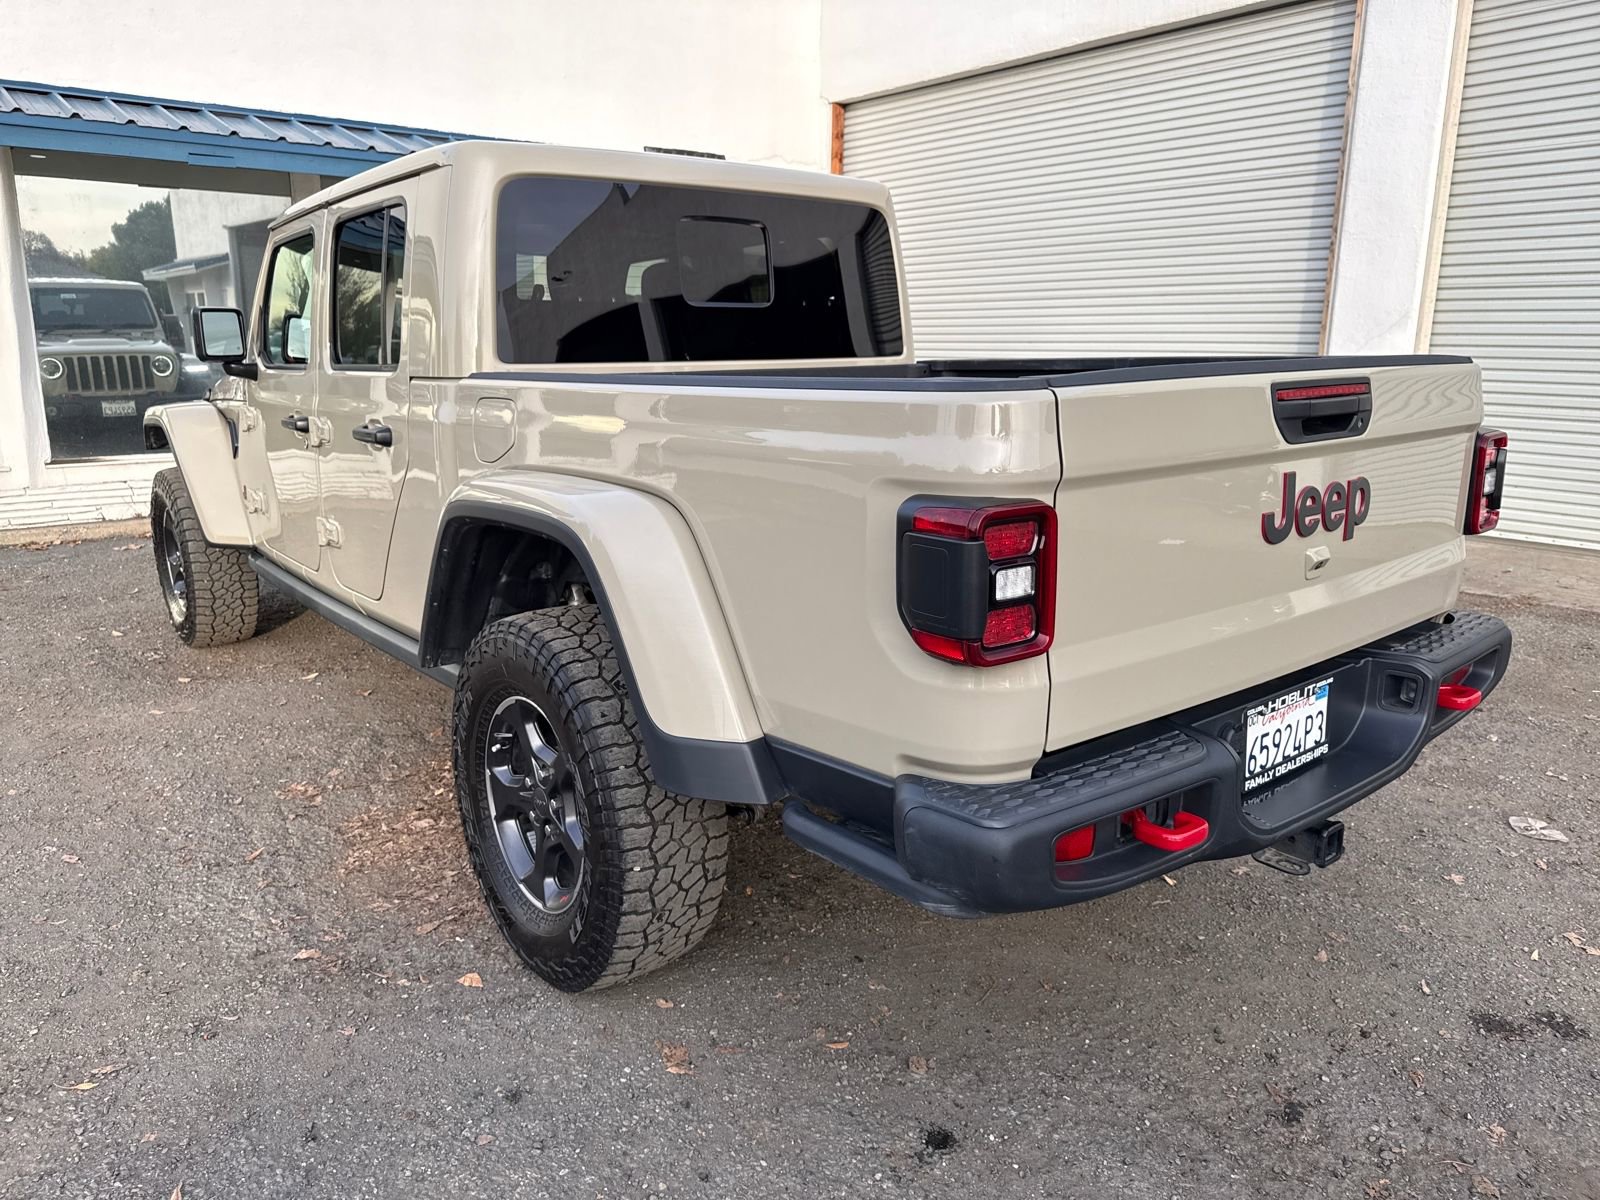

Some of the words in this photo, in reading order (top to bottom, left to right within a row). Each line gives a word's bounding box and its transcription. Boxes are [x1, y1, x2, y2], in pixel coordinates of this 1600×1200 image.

[1261, 471, 1371, 545] Jeep
[1267, 683, 1317, 713] HOBLIT
[1244, 769, 1275, 791] FAMILY
[1275, 743, 1329, 777] DEALERSHIPS
[1247, 710, 1325, 776] 65924P3
